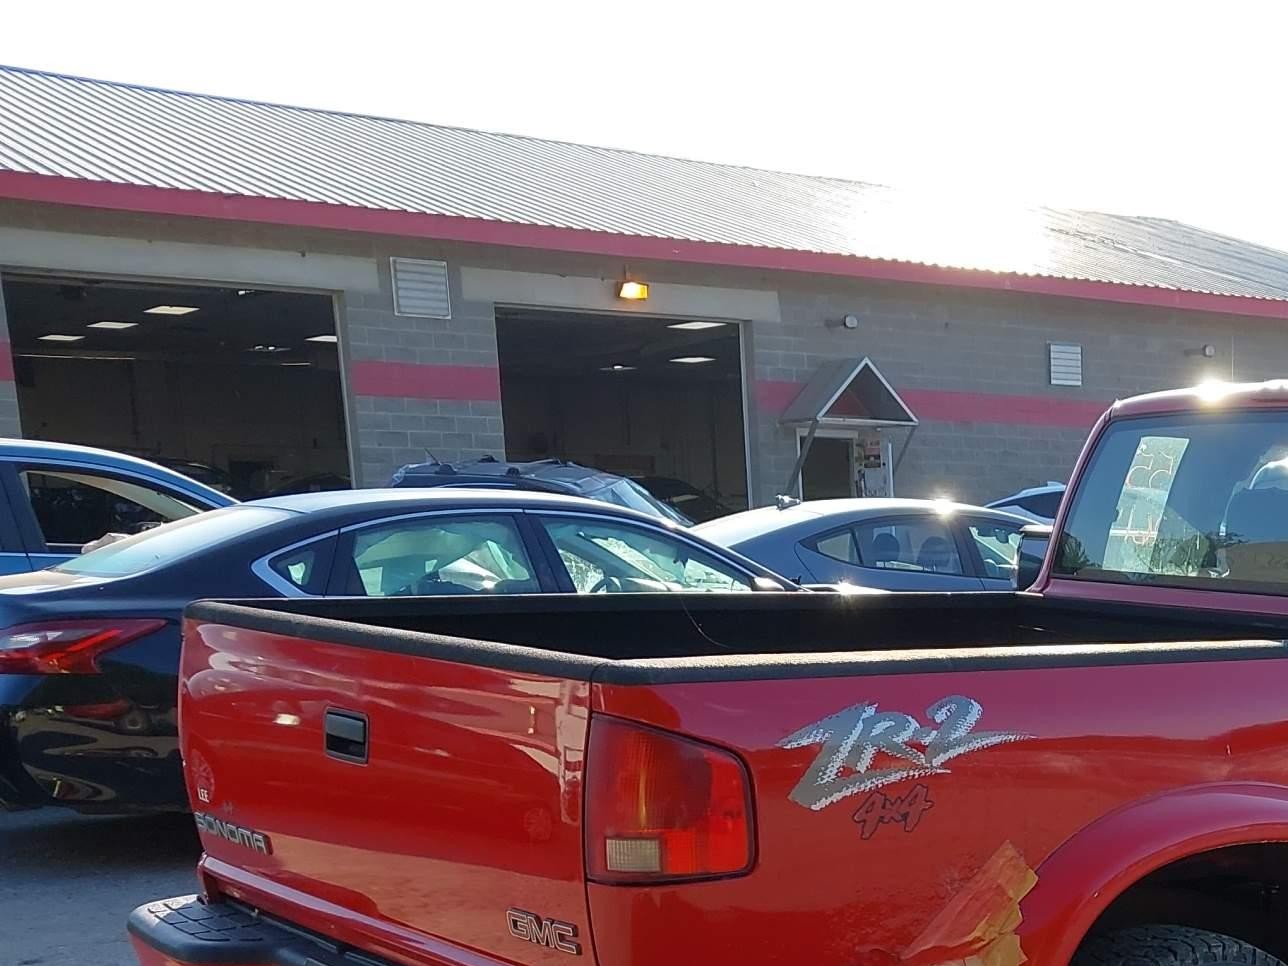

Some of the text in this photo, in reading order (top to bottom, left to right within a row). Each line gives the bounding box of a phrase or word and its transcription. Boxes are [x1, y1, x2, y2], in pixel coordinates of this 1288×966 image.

[775, 695, 1037, 811] ZR2
[194, 811, 269, 855] SONOMA
[506, 908, 579, 955] GMC
